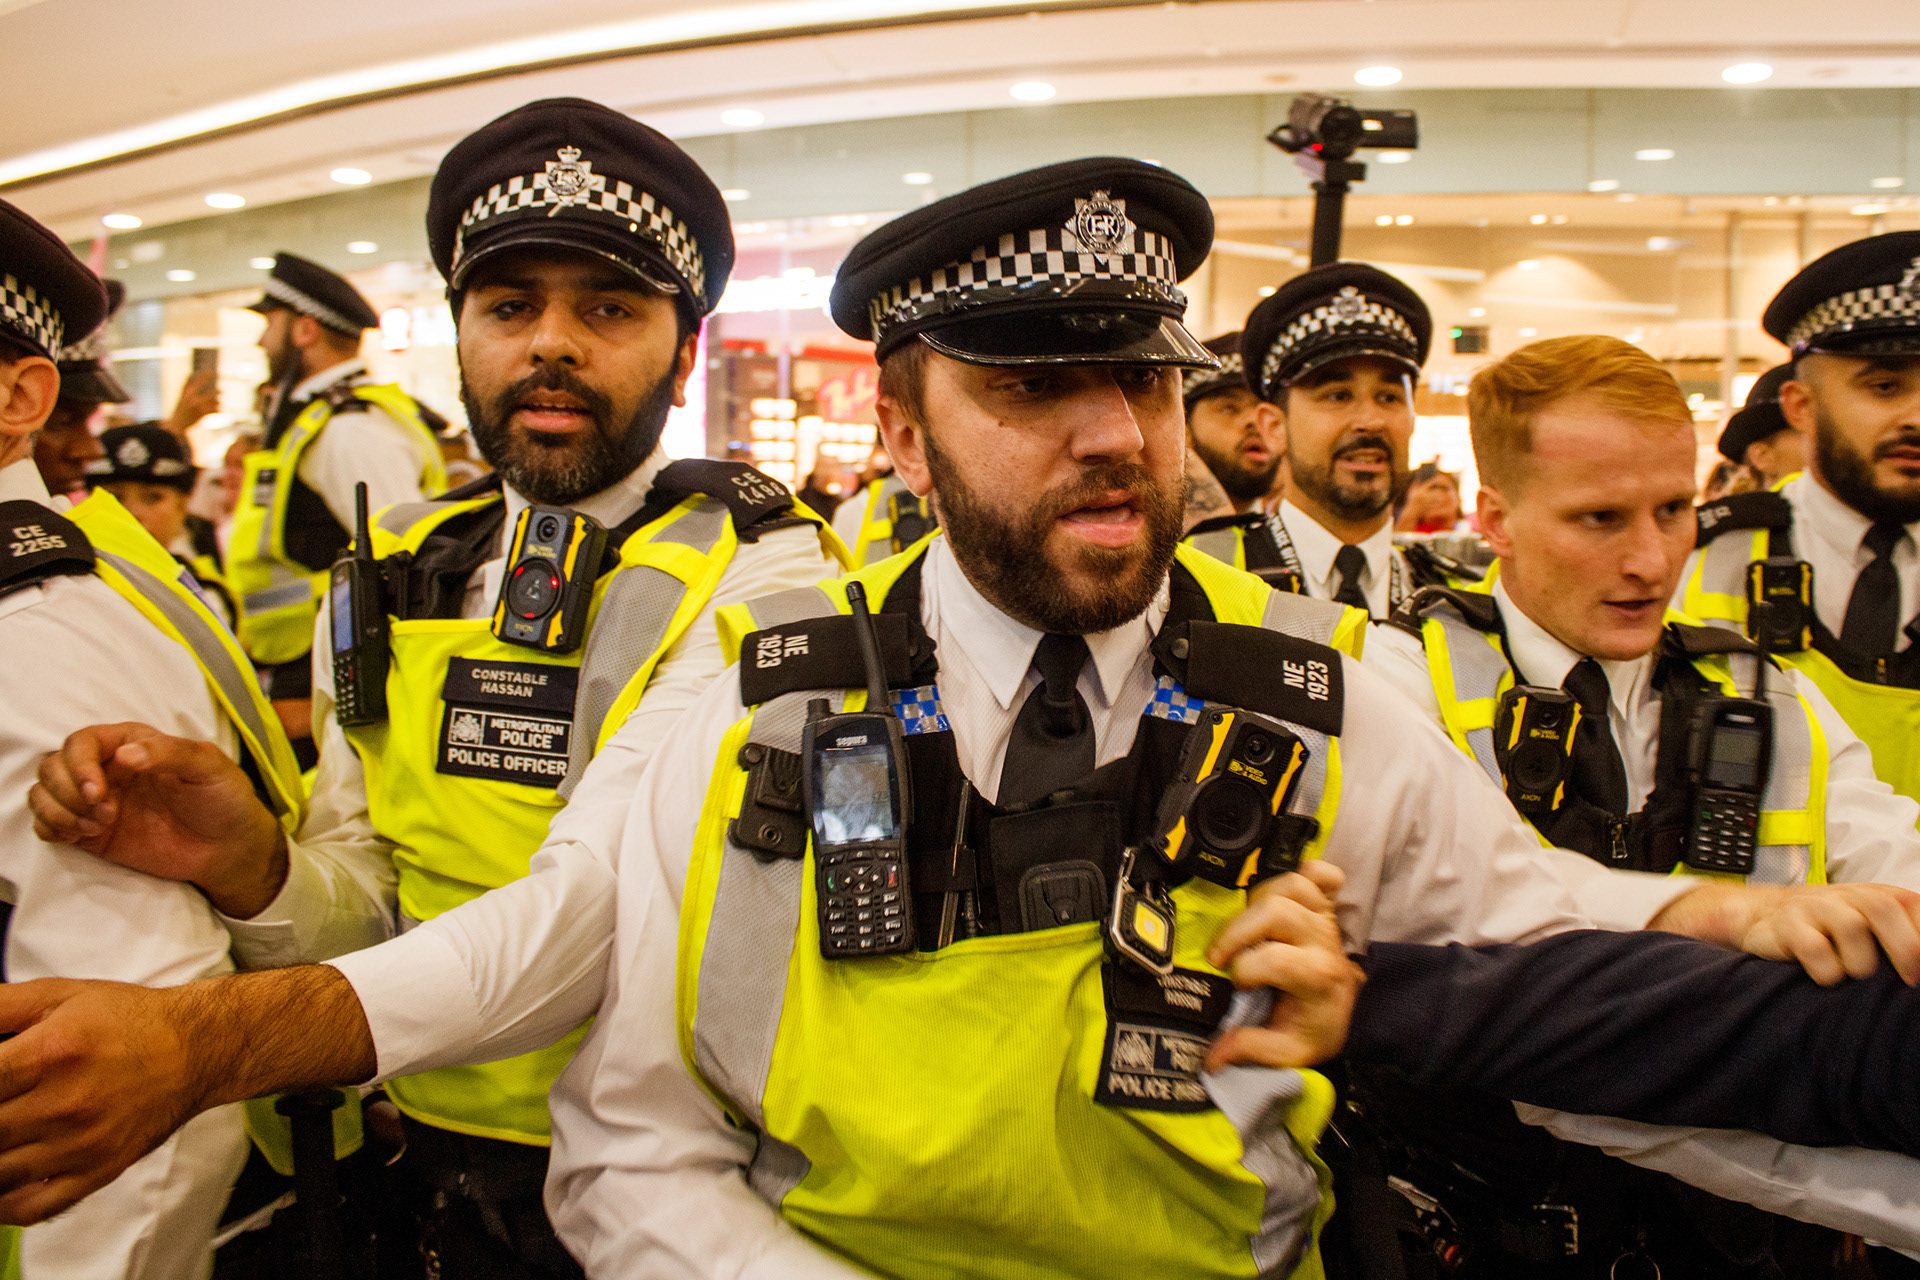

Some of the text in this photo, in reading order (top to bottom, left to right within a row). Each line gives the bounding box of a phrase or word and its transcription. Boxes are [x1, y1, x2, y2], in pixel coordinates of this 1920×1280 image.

[1090, 214, 1118, 239] ER
[731, 472, 762, 487] CE
[12, 524, 48, 540] CE
[9, 535, 68, 557] 2255
[756, 634, 783, 669] 1923
[783, 634, 809, 658] NE
[471, 668, 549, 686] CONSTABLE
[1282, 660, 1305, 689] NE
[1306, 660, 1330, 701] 1923
[480, 681, 534, 698] HASSAN
[490, 718, 565, 736] METROPOLITAN
[500, 730, 553, 749] POLICE
[447, 747, 568, 776] POLICE OFFICER
[1520, 794, 1541, 802] AXON
